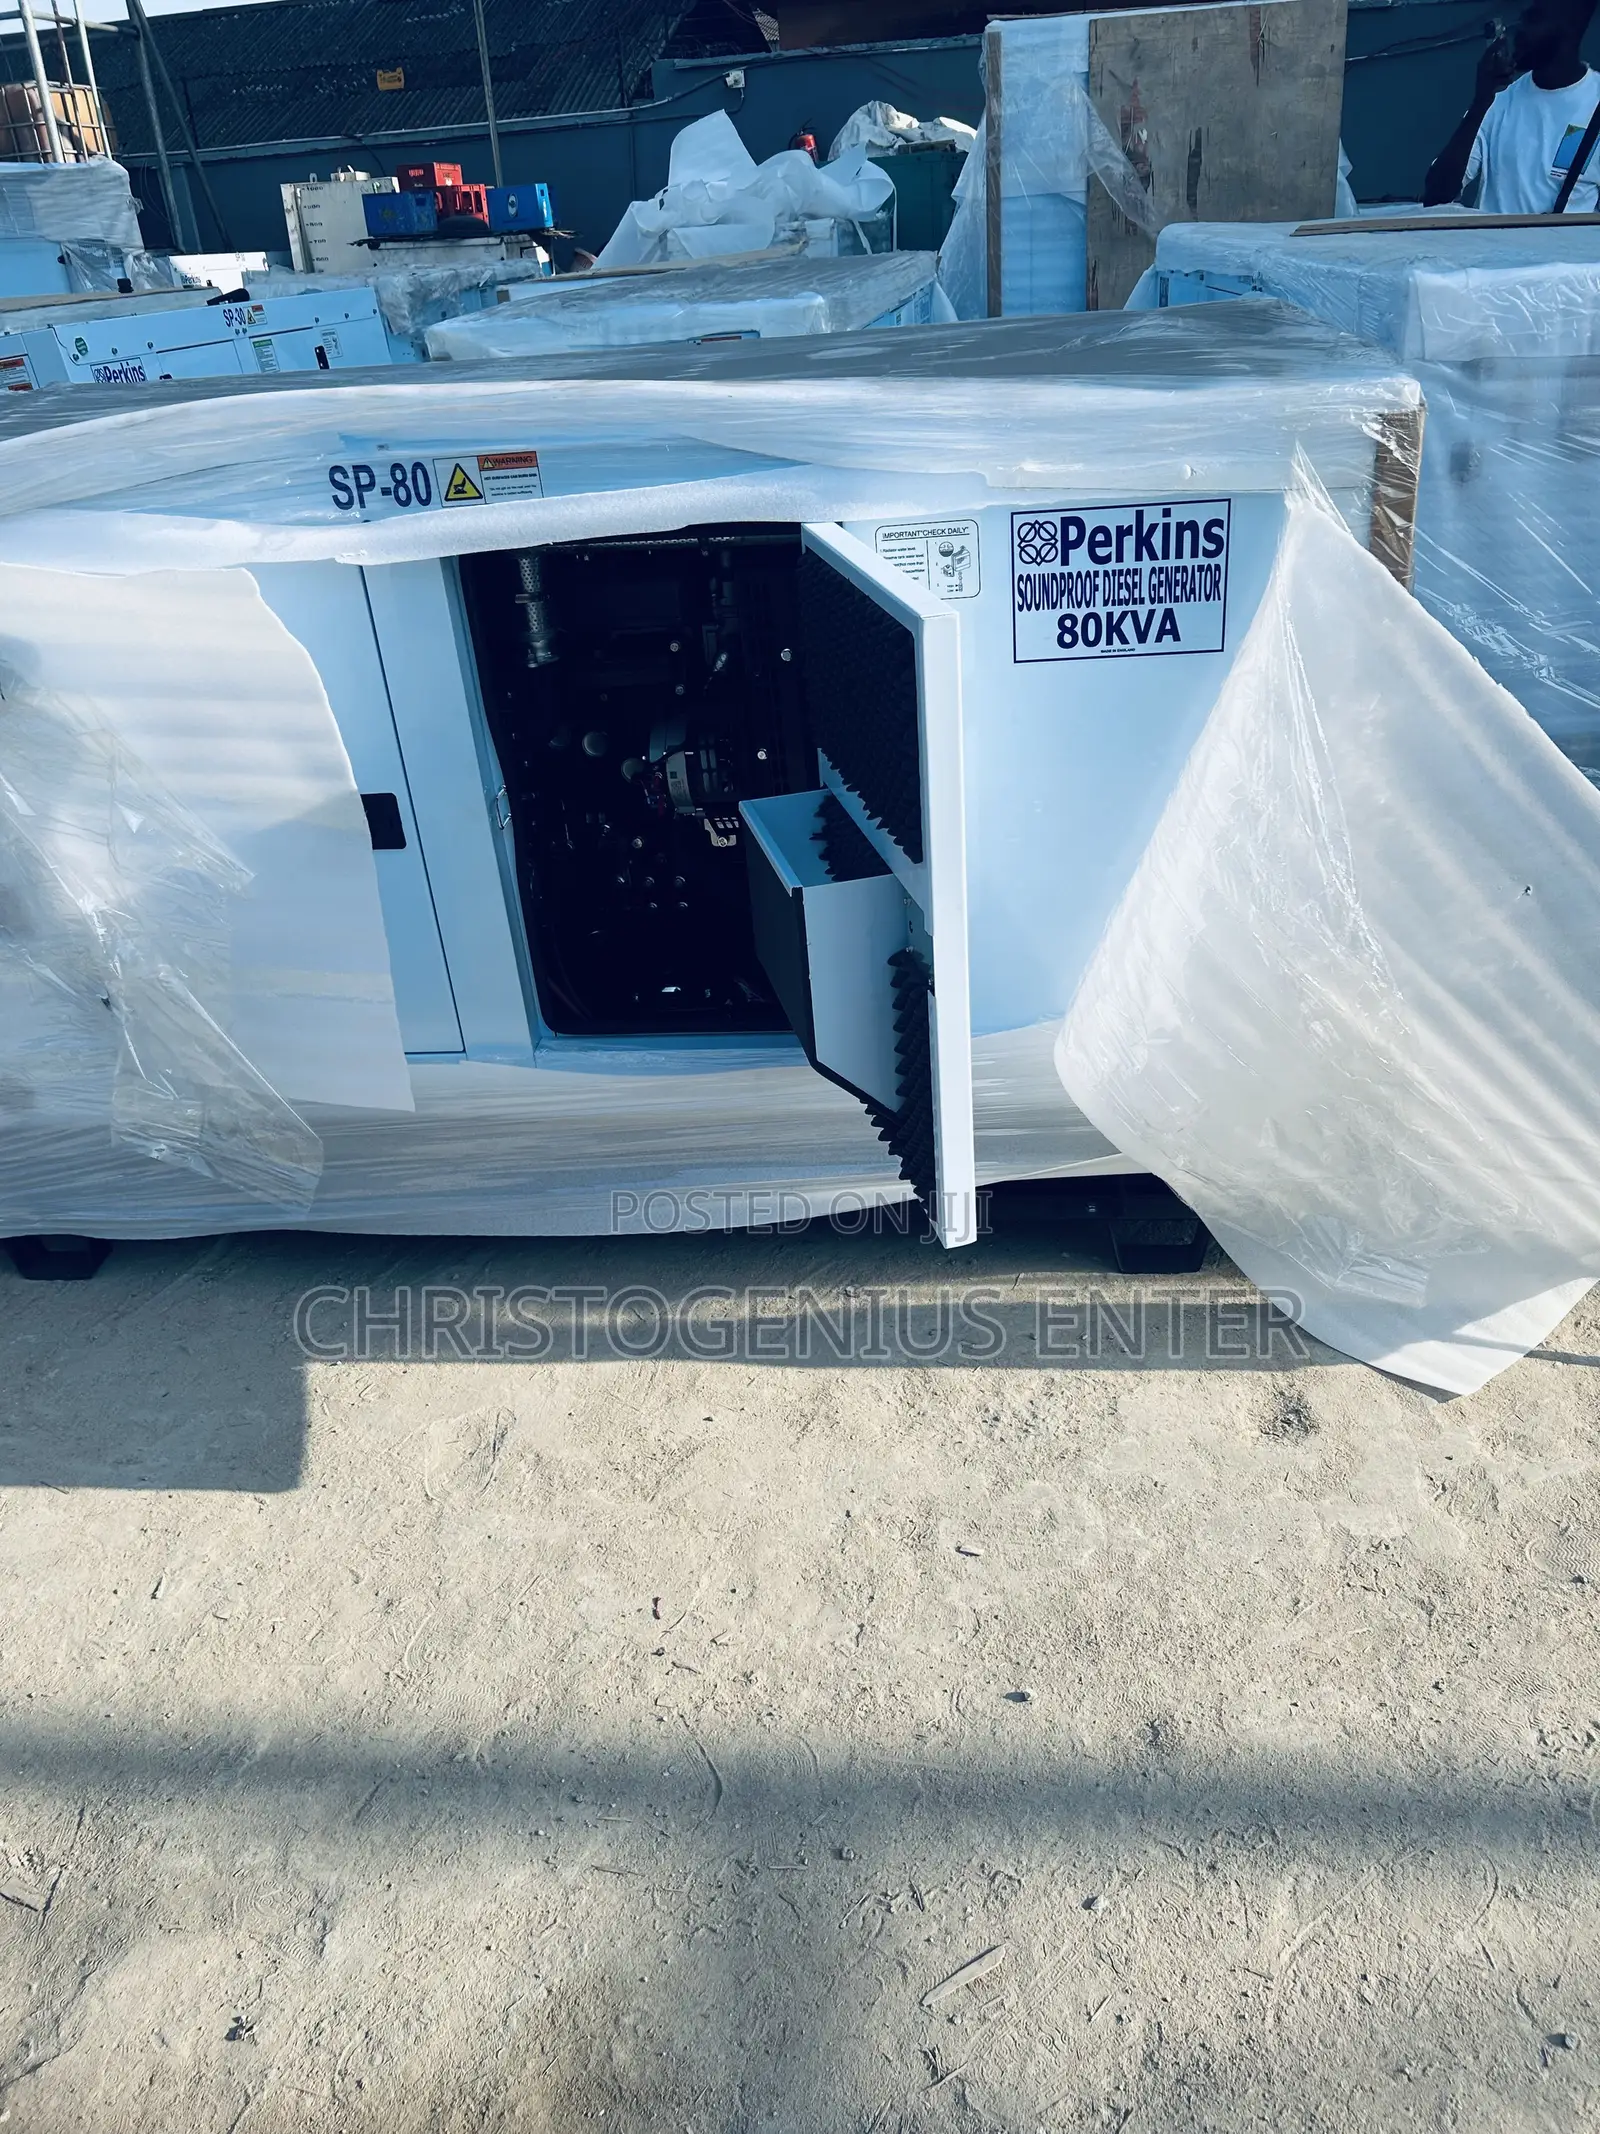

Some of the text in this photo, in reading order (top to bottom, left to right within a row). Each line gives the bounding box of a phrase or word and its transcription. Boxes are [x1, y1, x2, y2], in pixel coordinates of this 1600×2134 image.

[223, 307, 247, 328] SP-30
[103, 360, 146, 383] Perkins
[493, 456, 533, 466] WARNING
[328, 461, 432, 510] SP-80
[1060, 508, 1225, 566] Perkins
[1017, 563, 1222, 612] SOUNDPROOF DIESEL GENERATOR
[1056, 608, 1181, 650] 80KVA
